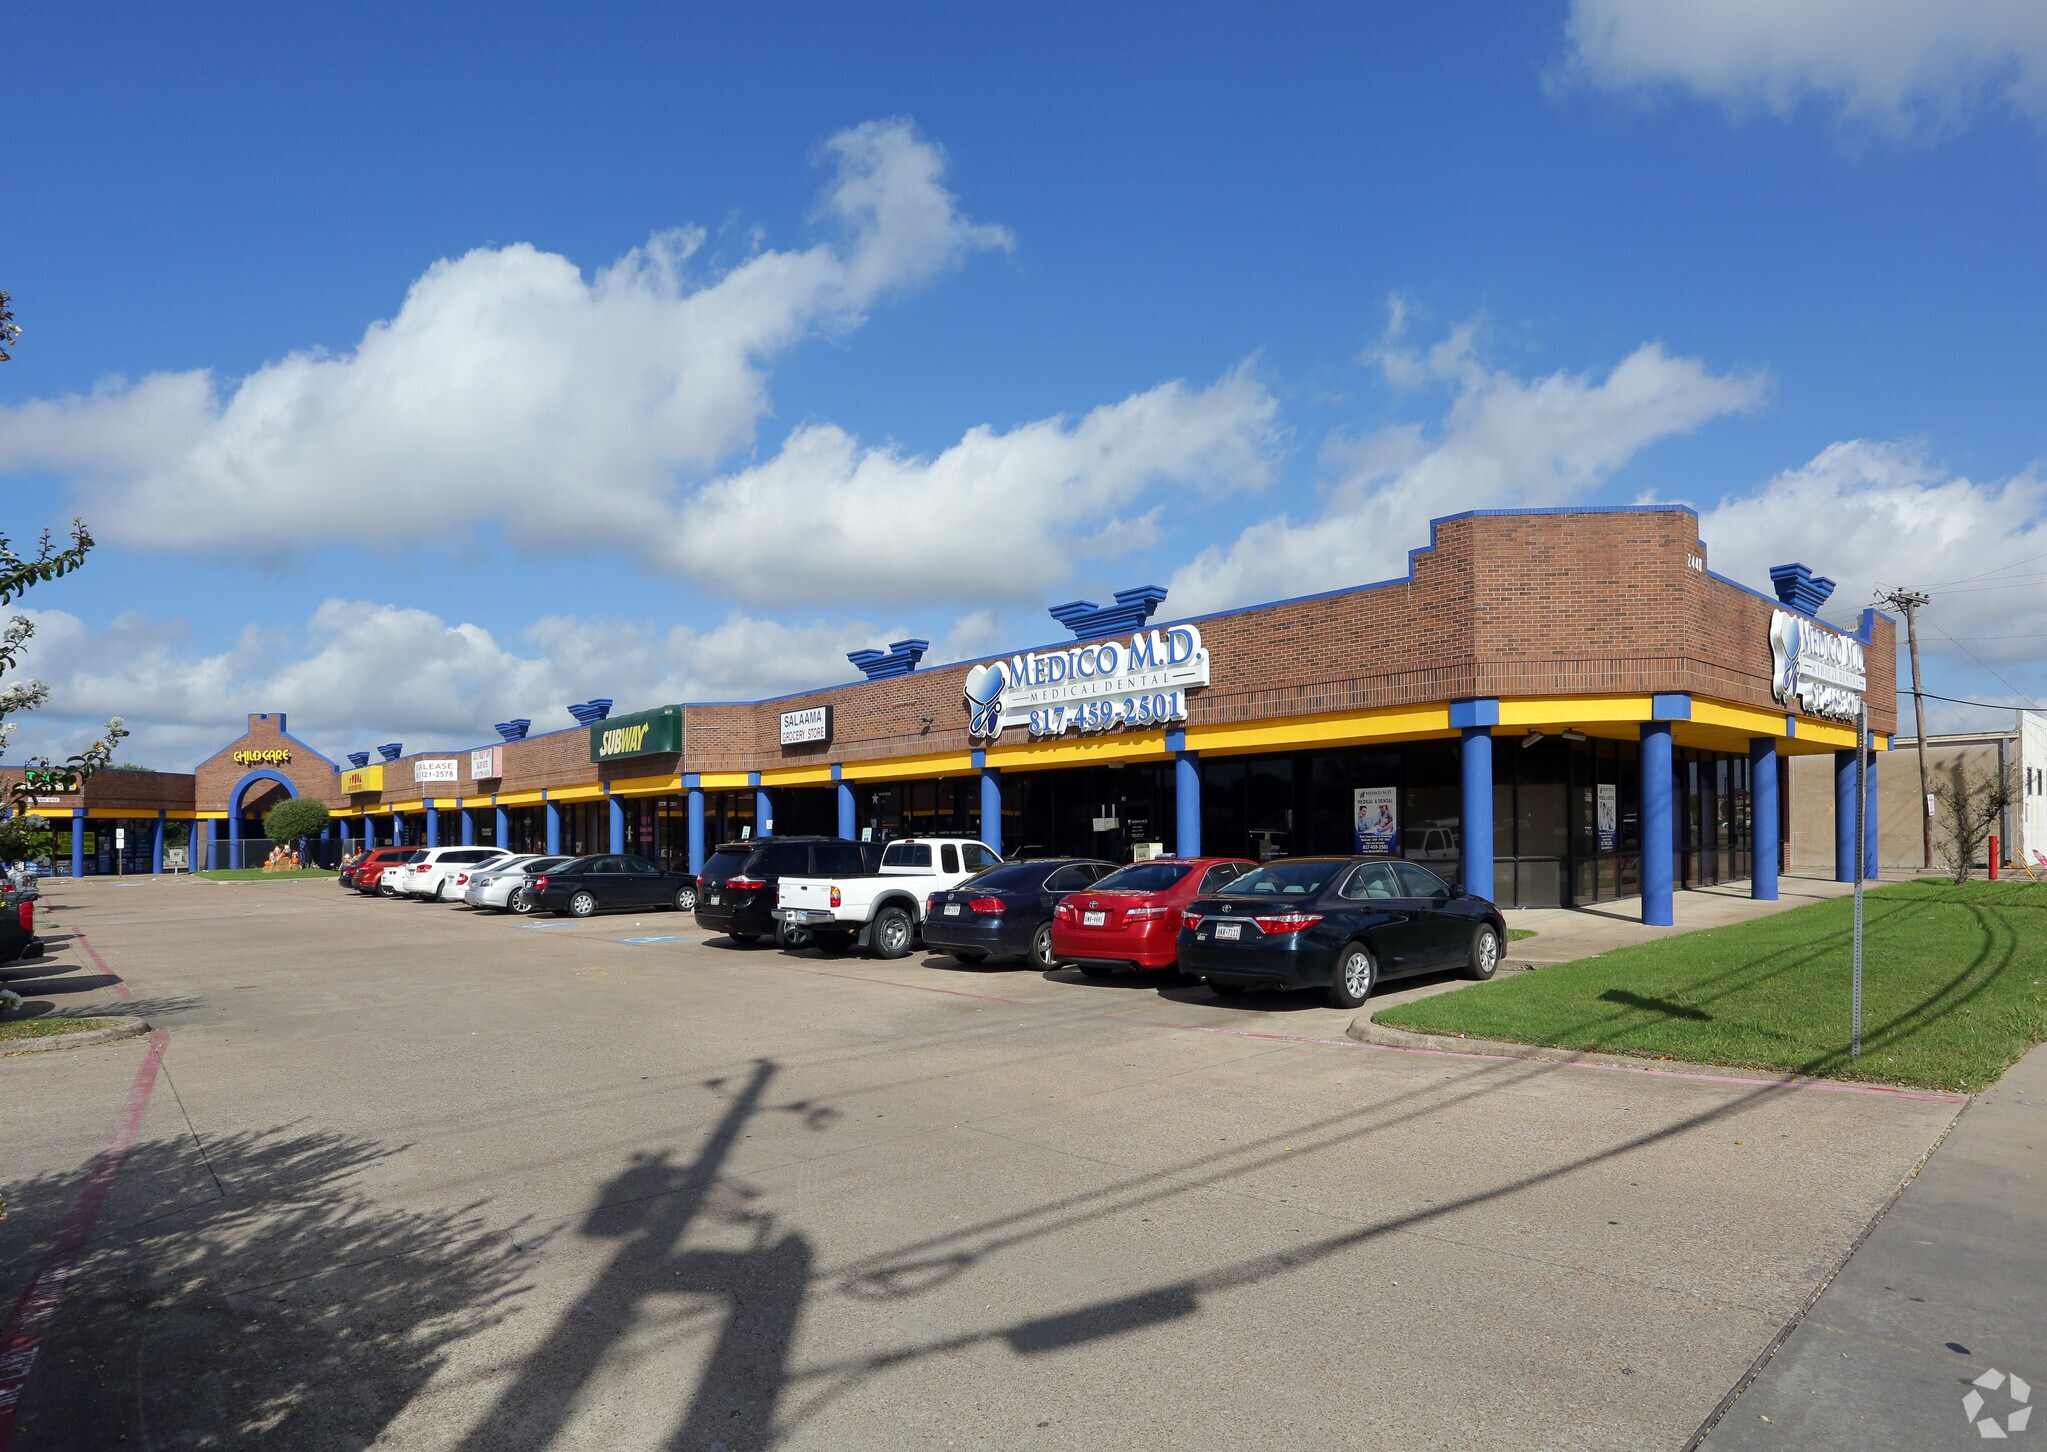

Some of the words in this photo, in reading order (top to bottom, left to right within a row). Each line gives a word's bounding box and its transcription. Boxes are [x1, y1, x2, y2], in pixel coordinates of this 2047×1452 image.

[1687, 553, 1703, 573] 2440
[1008, 645, 1119, 690] MEDICO
[1127, 628, 1202, 671] M.D.
[783, 710, 823, 728] SALAAMA
[1029, 690, 1181, 734] 817-459-2501
[599, 721, 649, 757] SUBWAY
[782, 729, 805, 743] GROCERY
[807, 726, 824, 739] STORE
[233, 750, 261, 765] CHILD
[262, 749, 290, 763] CARE
[423, 762, 454, 770] LEASE
